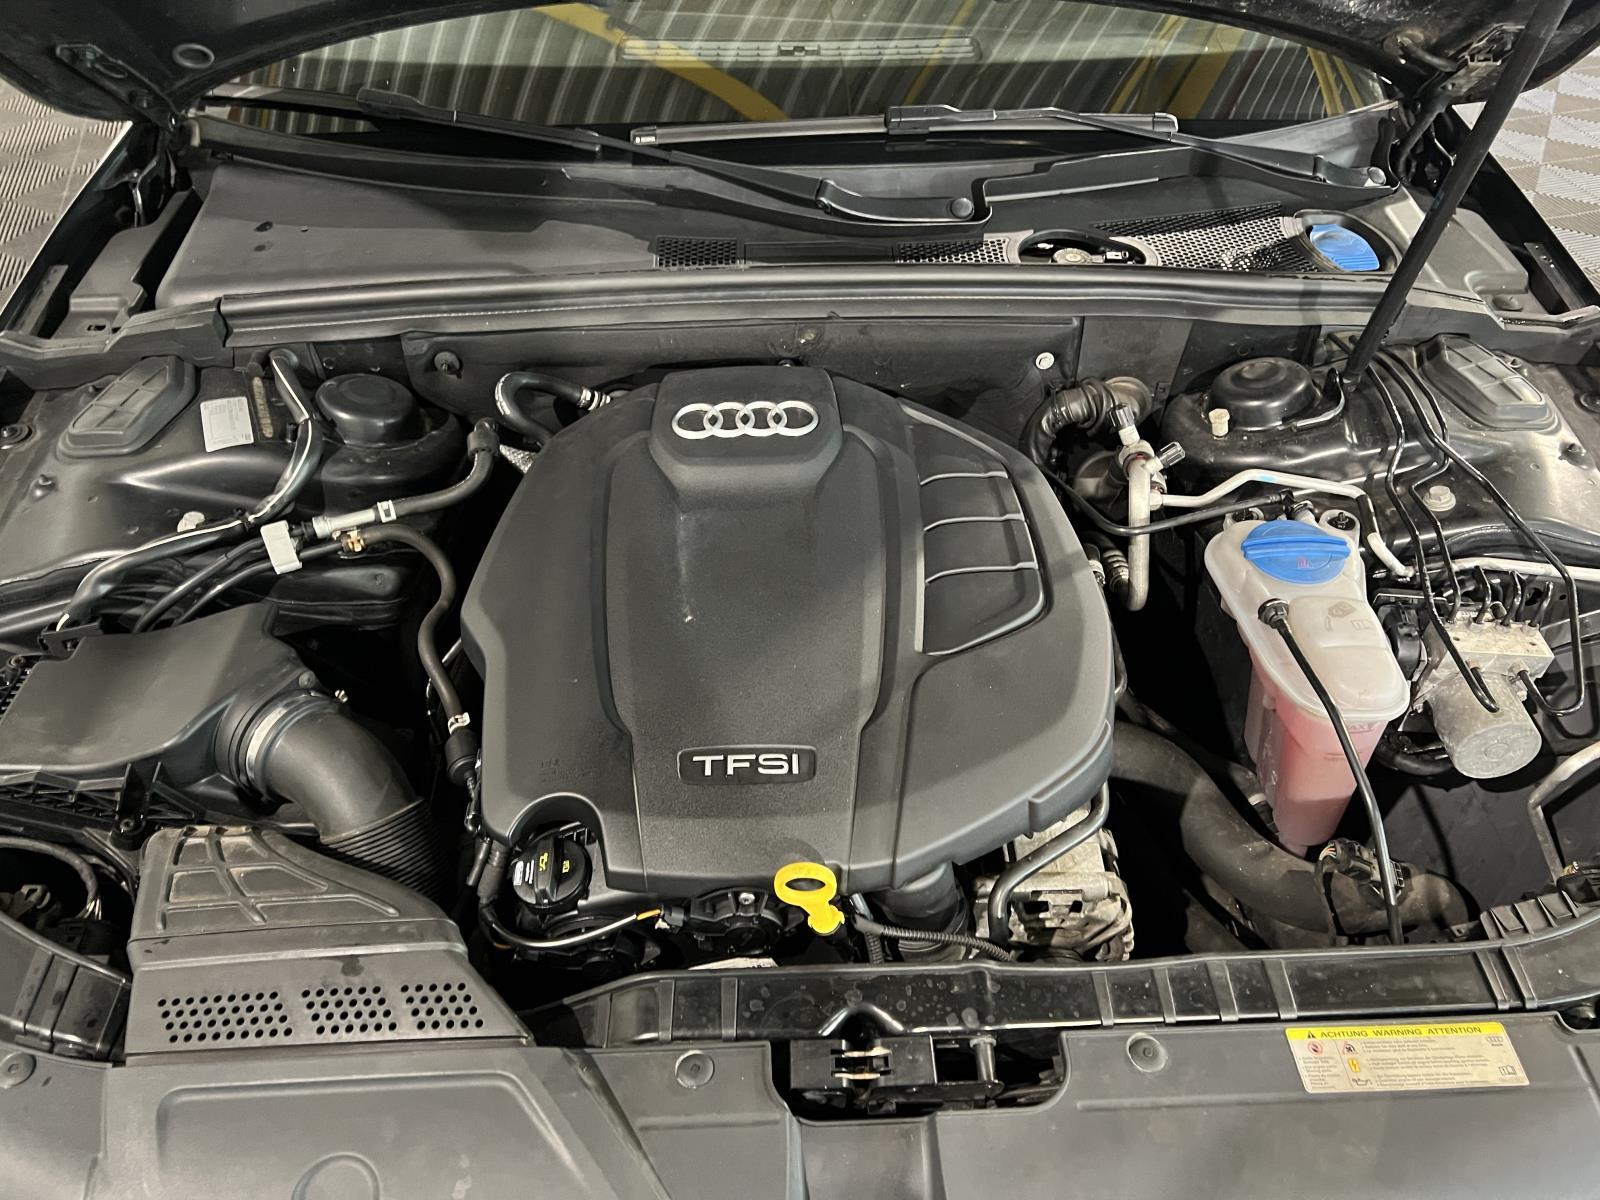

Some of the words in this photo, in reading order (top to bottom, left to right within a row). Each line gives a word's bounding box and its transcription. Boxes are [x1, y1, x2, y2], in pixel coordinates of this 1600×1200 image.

[692, 753, 799, 776] TFSI
[1320, 1030, 1369, 1038] ACHTUNG
[1372, 1028, 1422, 1036] WARNING
[1427, 1025, 1482, 1035] ATTENTION
